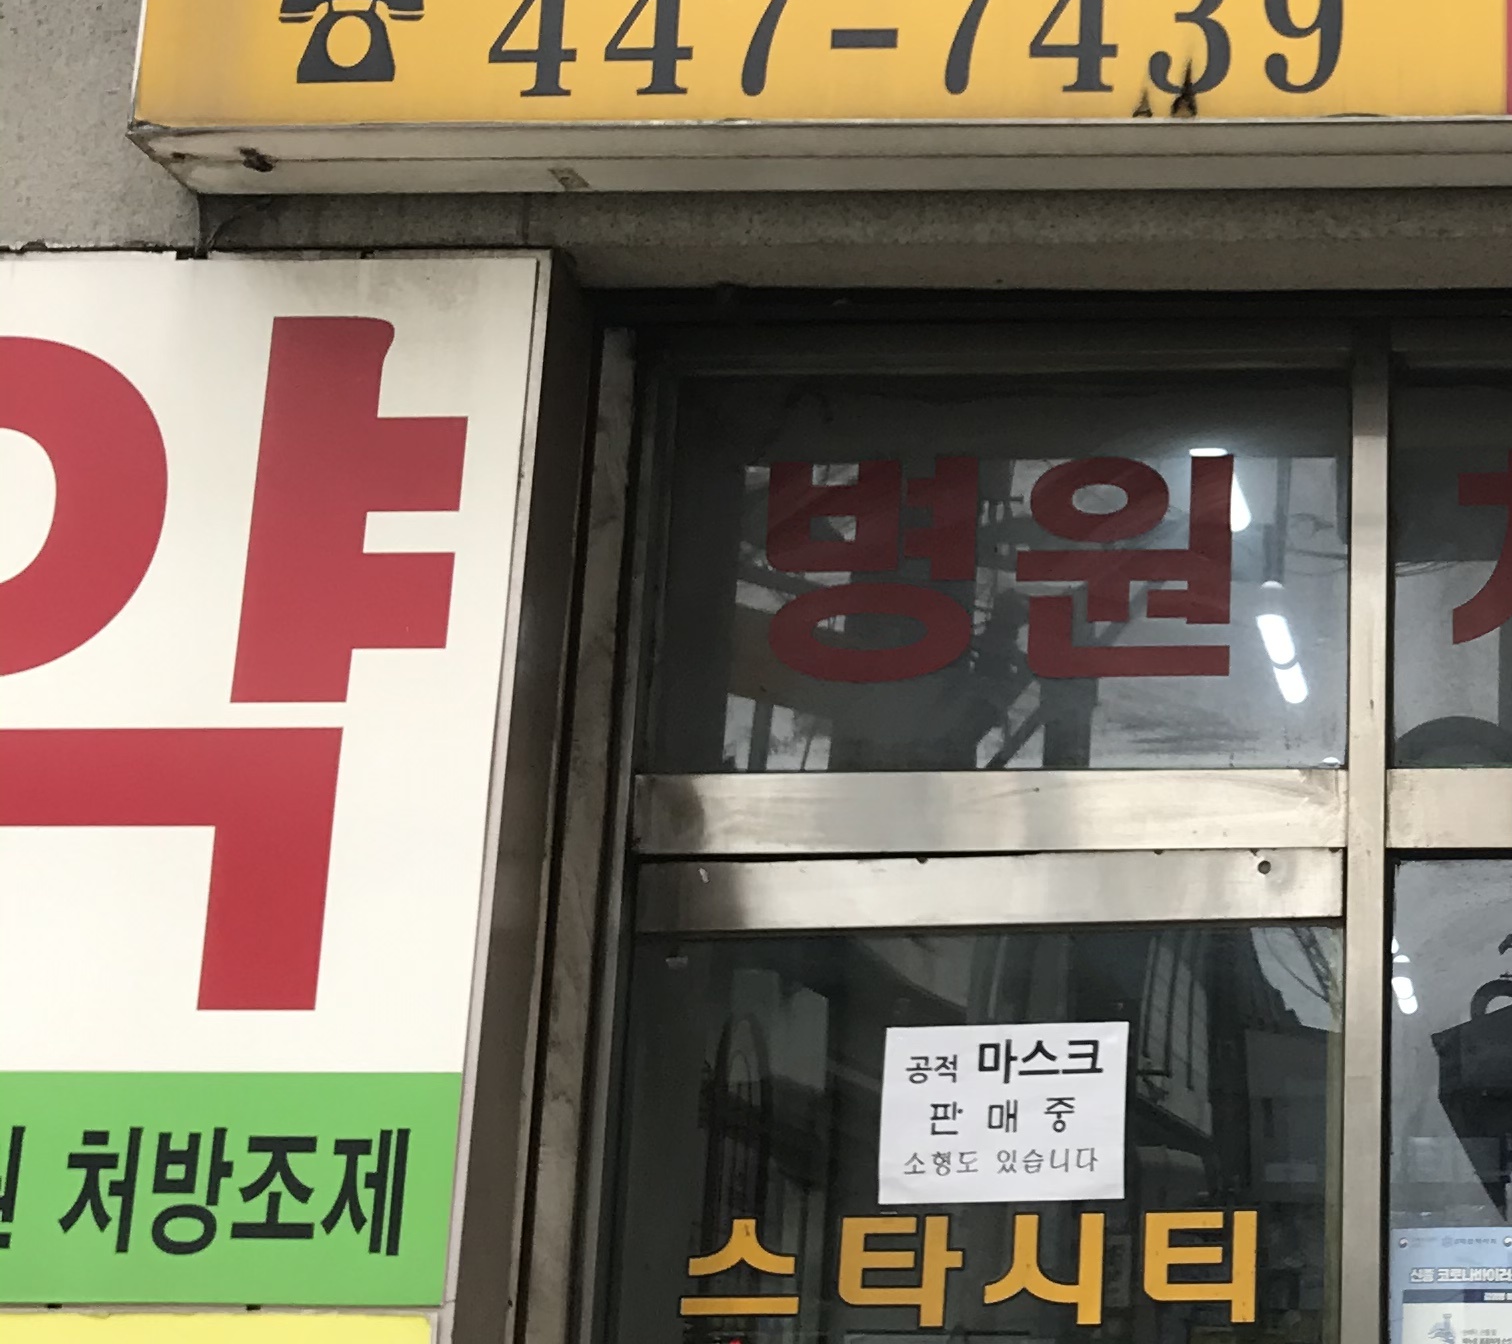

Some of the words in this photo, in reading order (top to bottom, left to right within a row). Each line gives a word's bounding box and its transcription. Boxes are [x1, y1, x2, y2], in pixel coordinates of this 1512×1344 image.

[766, 453, 1234, 683] 병원
[0, 316, 468, 1010] 약
[905, 1053, 958, 1084] 공적
[978, 1039, 1104, 1084] 마스크
[58, 1125, 411, 1256] 처방조제
[904, 1151, 979, 1176] 소형도
[997, 1147, 1099, 1174] 있습니다
[680, 1210, 1258, 1327] 스타시티
